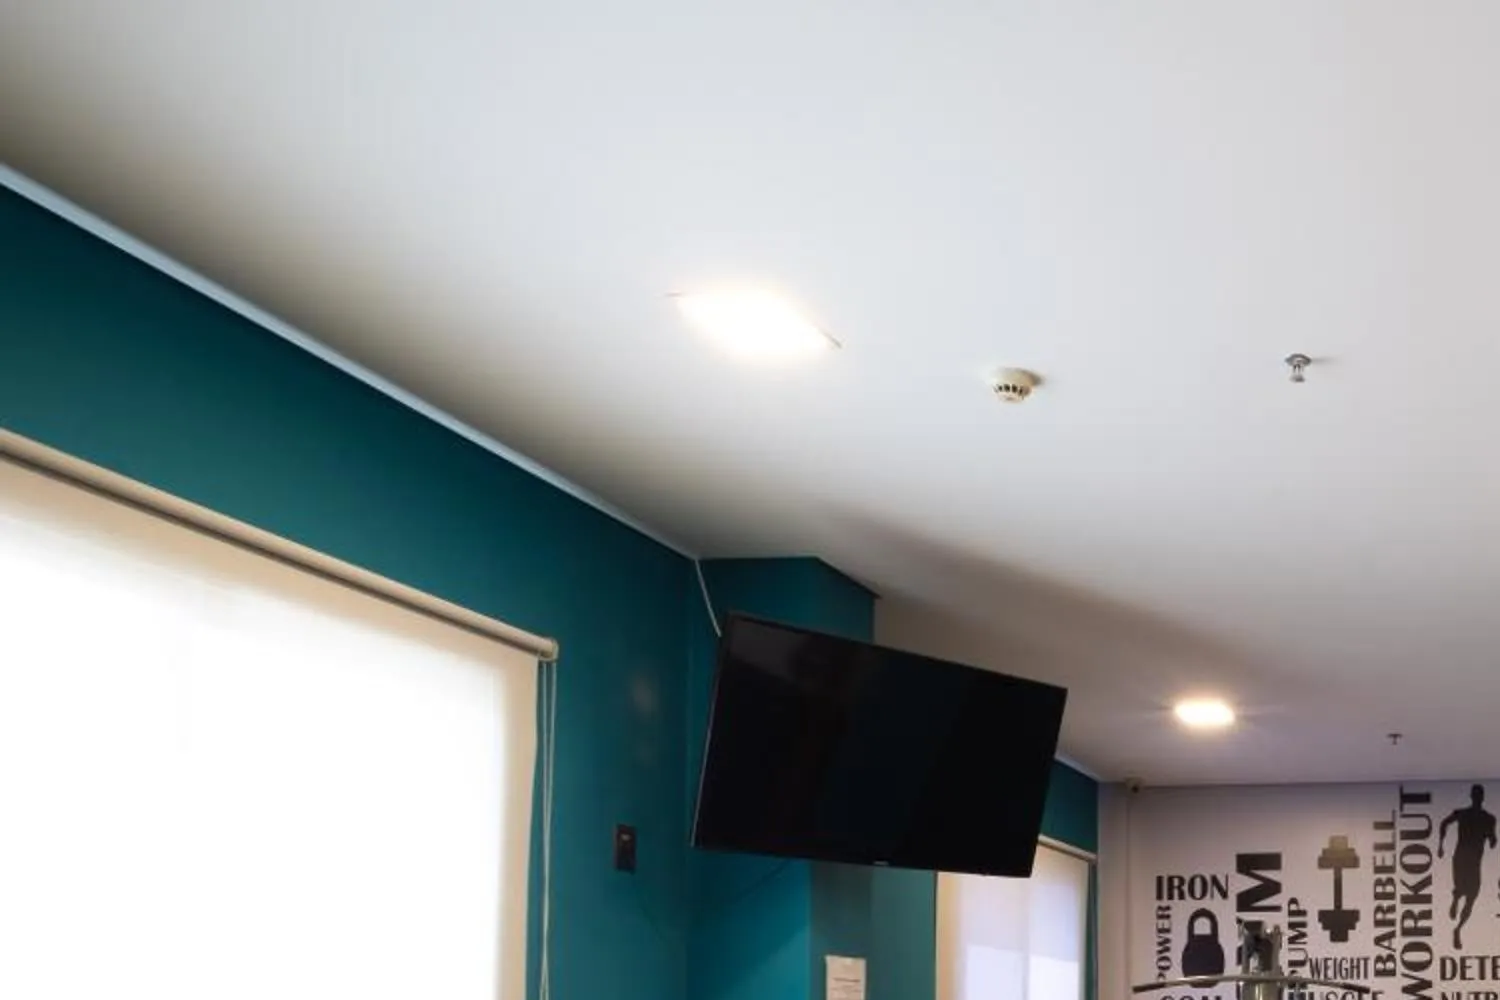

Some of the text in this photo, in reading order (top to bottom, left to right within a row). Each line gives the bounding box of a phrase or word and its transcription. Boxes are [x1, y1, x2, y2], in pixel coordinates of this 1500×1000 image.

[1156, 874, 1229, 900] IRON
[1373, 809, 1397, 977] BARBELL
[1309, 957, 1370, 979] WEIGHT
